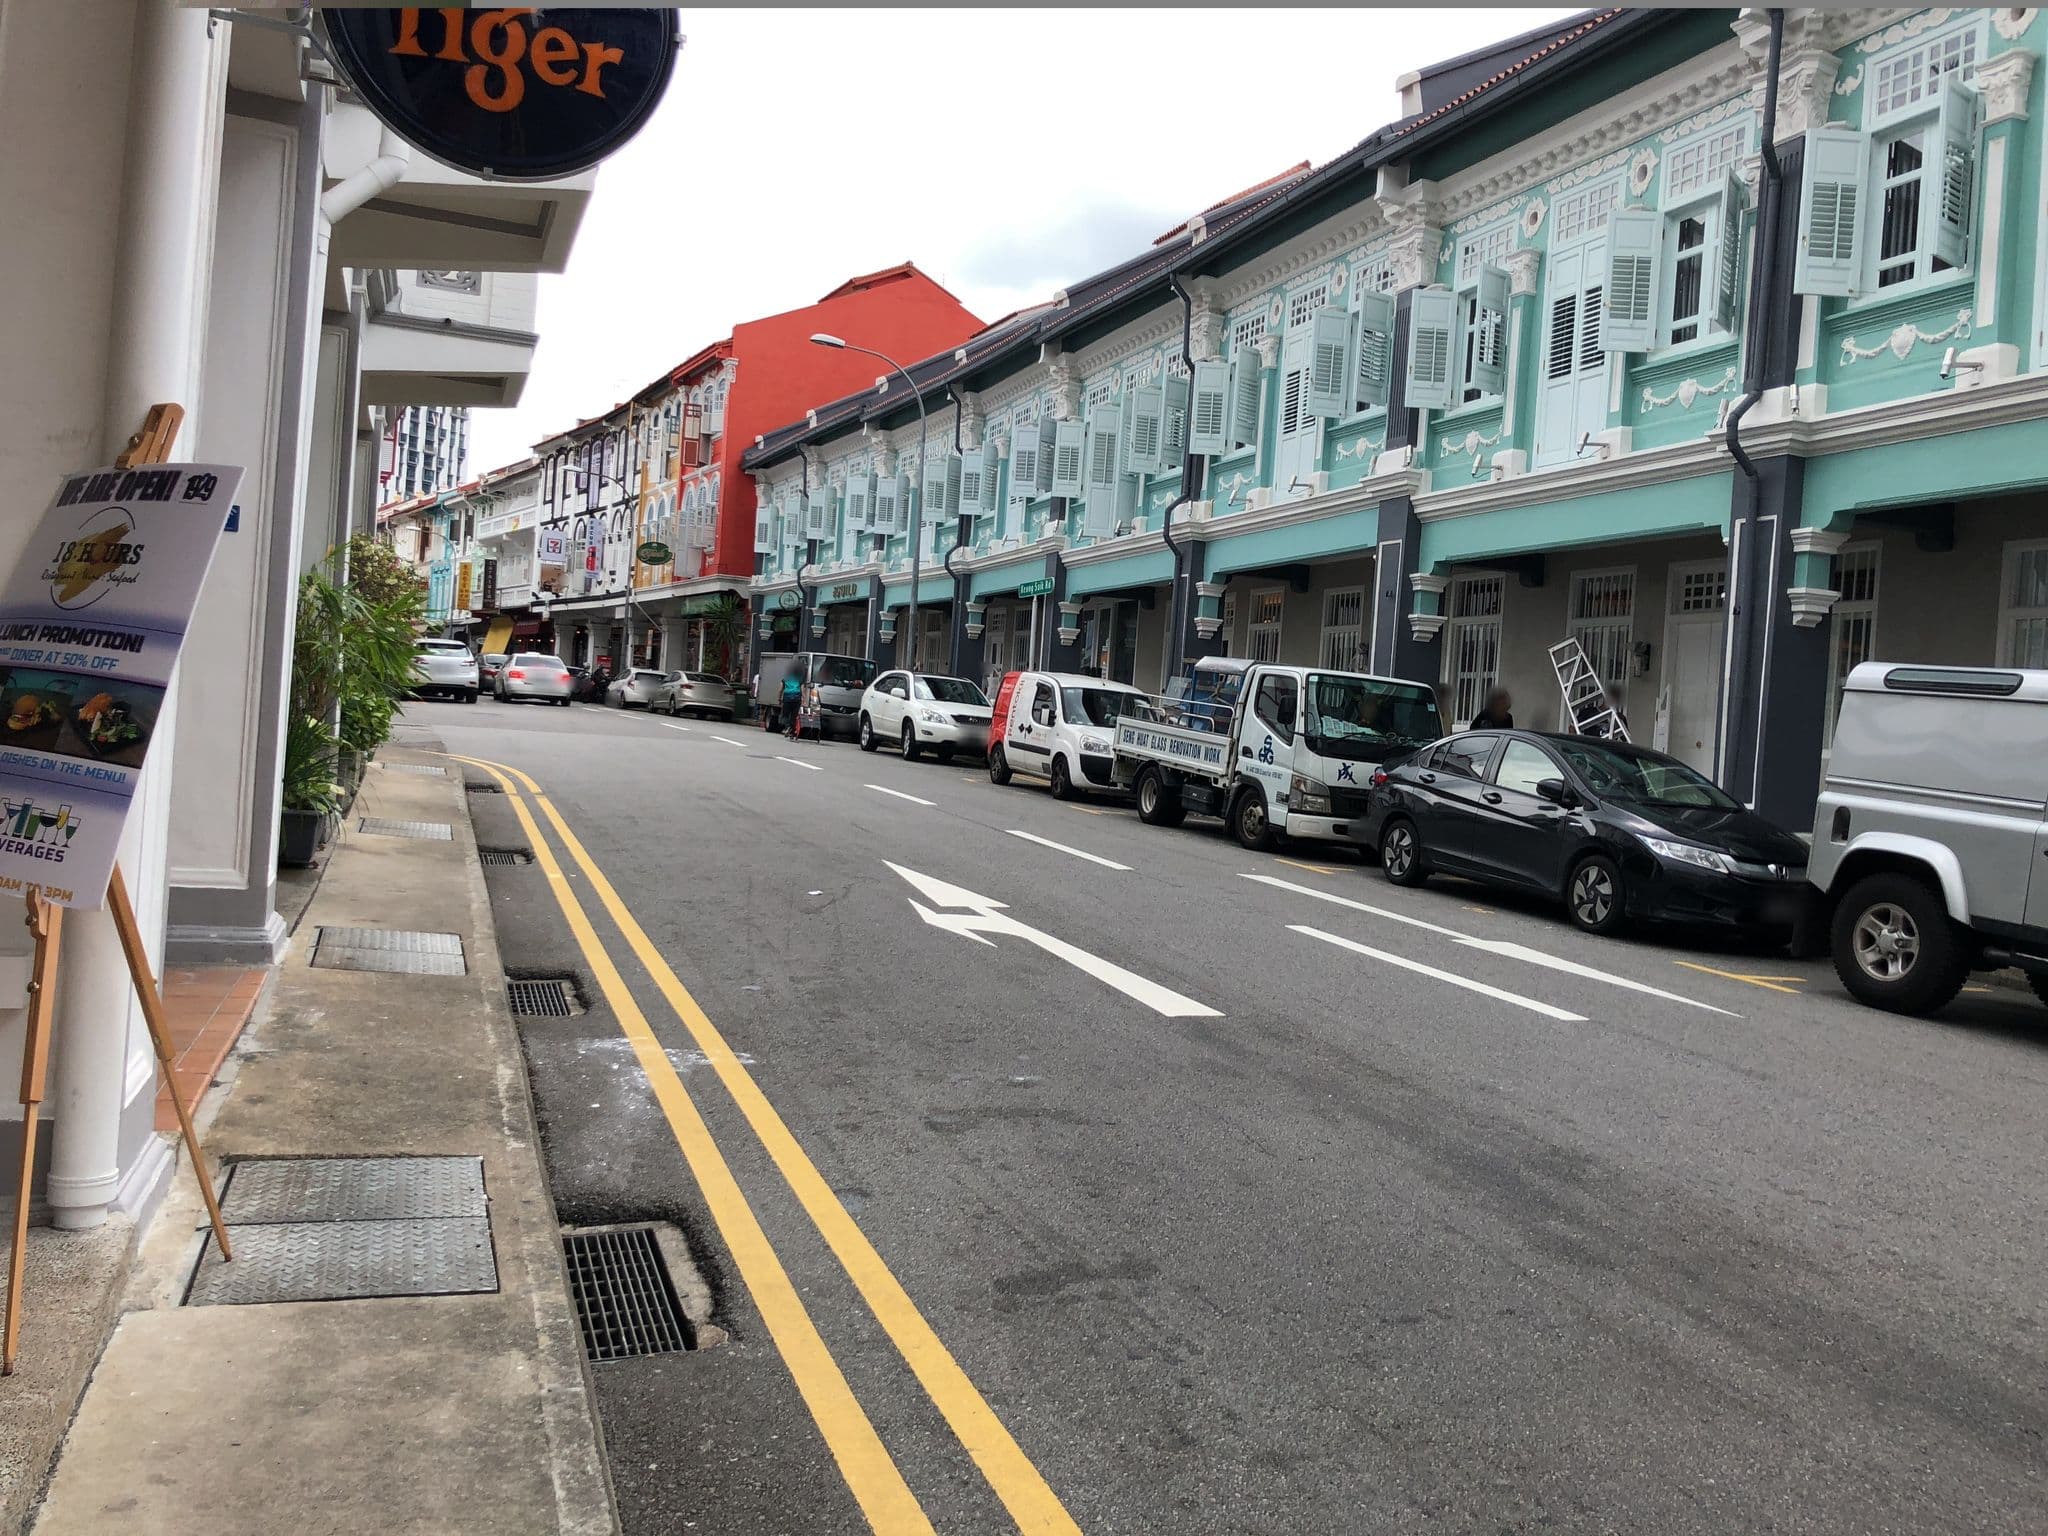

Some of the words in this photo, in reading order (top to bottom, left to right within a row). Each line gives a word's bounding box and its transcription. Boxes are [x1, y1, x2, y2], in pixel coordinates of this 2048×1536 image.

[115, 470, 183, 502] OPEN!
[37, 625, 146, 653] PROMOTION!
[10, 648, 43, 662] DINER
[43, 651, 61, 664] AT
[61, 652, 89, 667] 50%
[91, 656, 119, 670] OFF
[1123, 728, 1136, 745] SENG
[1136, 731, 1149, 747] HUAT
[1150, 735, 1167, 752] GLASS
[1169, 739, 1202, 760] RENOVATION
[1203, 746, 1222, 764] WORK
[1, 751, 39, 768] DISHES
[40, 758, 58, 771] ON
[60, 761, 83, 776] THE
[84, 766, 127, 784] MENU!
[0, 839, 65, 863] VERAGES
[44, 886, 73, 902] 3PM
